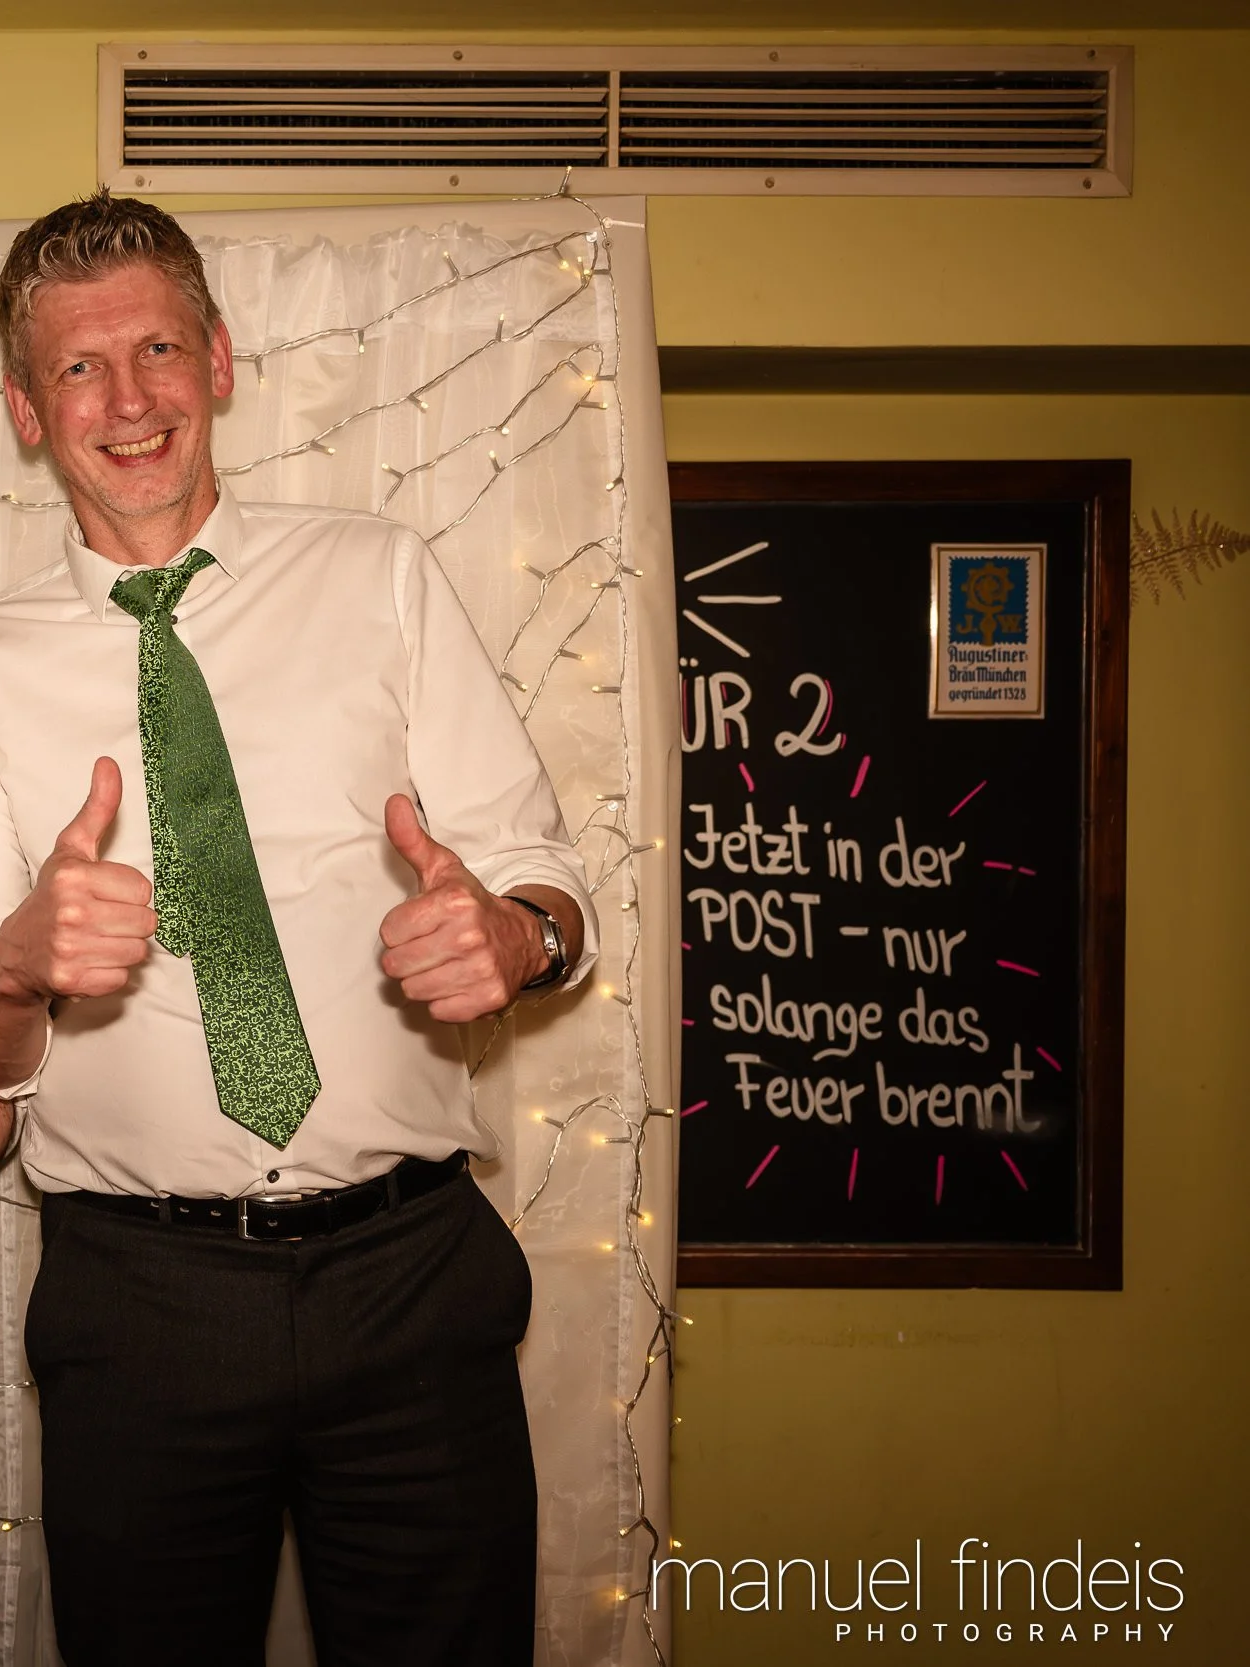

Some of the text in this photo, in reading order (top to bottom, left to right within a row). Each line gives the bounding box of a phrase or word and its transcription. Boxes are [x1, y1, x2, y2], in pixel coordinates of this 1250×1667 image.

[774, 672, 842, 757] 2
[948, 664, 1026, 683] Bräu München
[948, 686, 1027, 703] gegründet 1328
[684, 802, 966, 888] Jetzt in der
[687, 887, 821, 959] POST
[882, 928, 967, 976] nur
[710, 973, 990, 1062] solange das
[725, 1042, 1042, 1133] Feuer brennt
